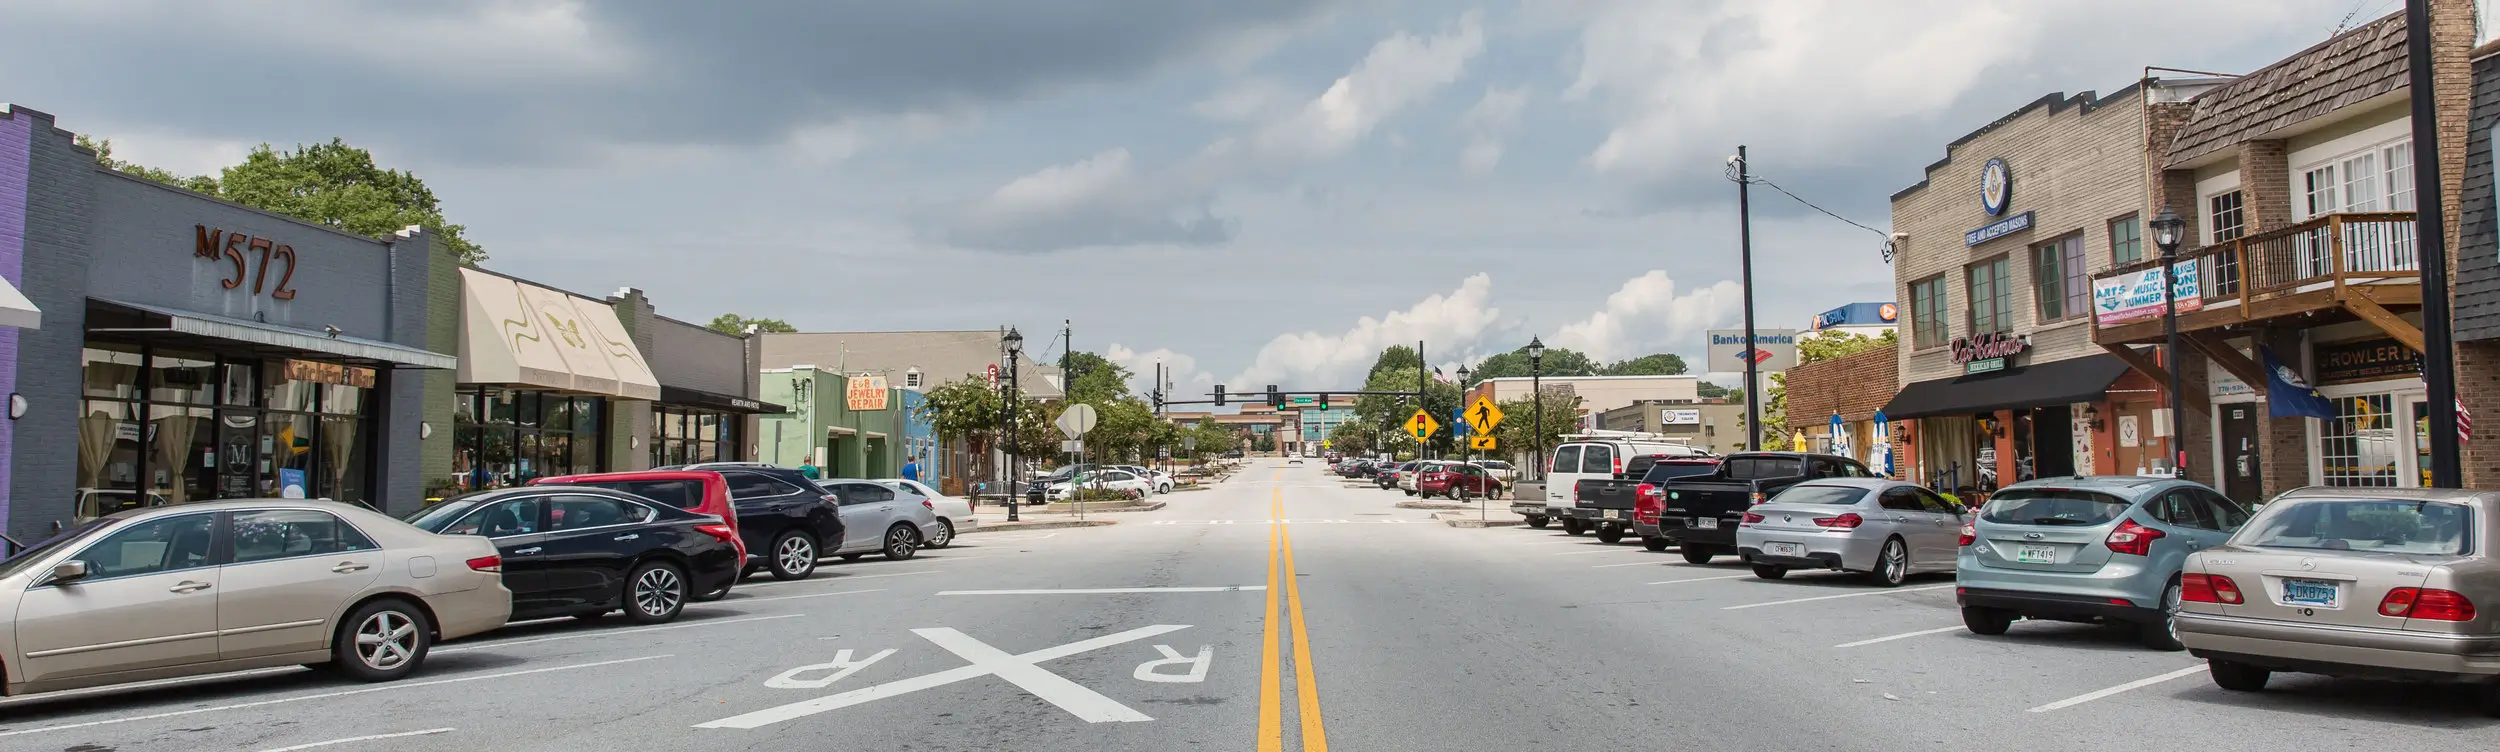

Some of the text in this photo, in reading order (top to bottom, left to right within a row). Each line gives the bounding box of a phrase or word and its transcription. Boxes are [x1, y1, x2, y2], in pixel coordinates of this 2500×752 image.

[1966, 214, 2028, 245] FREE AND ACCEPTED MASONS
[2144, 262, 2196, 282] ART ASSES
[2096, 285, 2126, 299] ARTS
[2133, 274, 2197, 296] MUSIC LONS
[2125, 292, 2162, 308] SUMMER
[1713, 334, 1740, 345] Bank
[1754, 333, 1793, 344] America
[1951, 331, 2023, 364] Las Colinas
[1970, 359, 2003, 372] MEXICAN GRILL
[853, 380, 859, 389] E
[848, 388, 886, 400] JEWELRY
[851, 398, 884, 409] REPAIR
